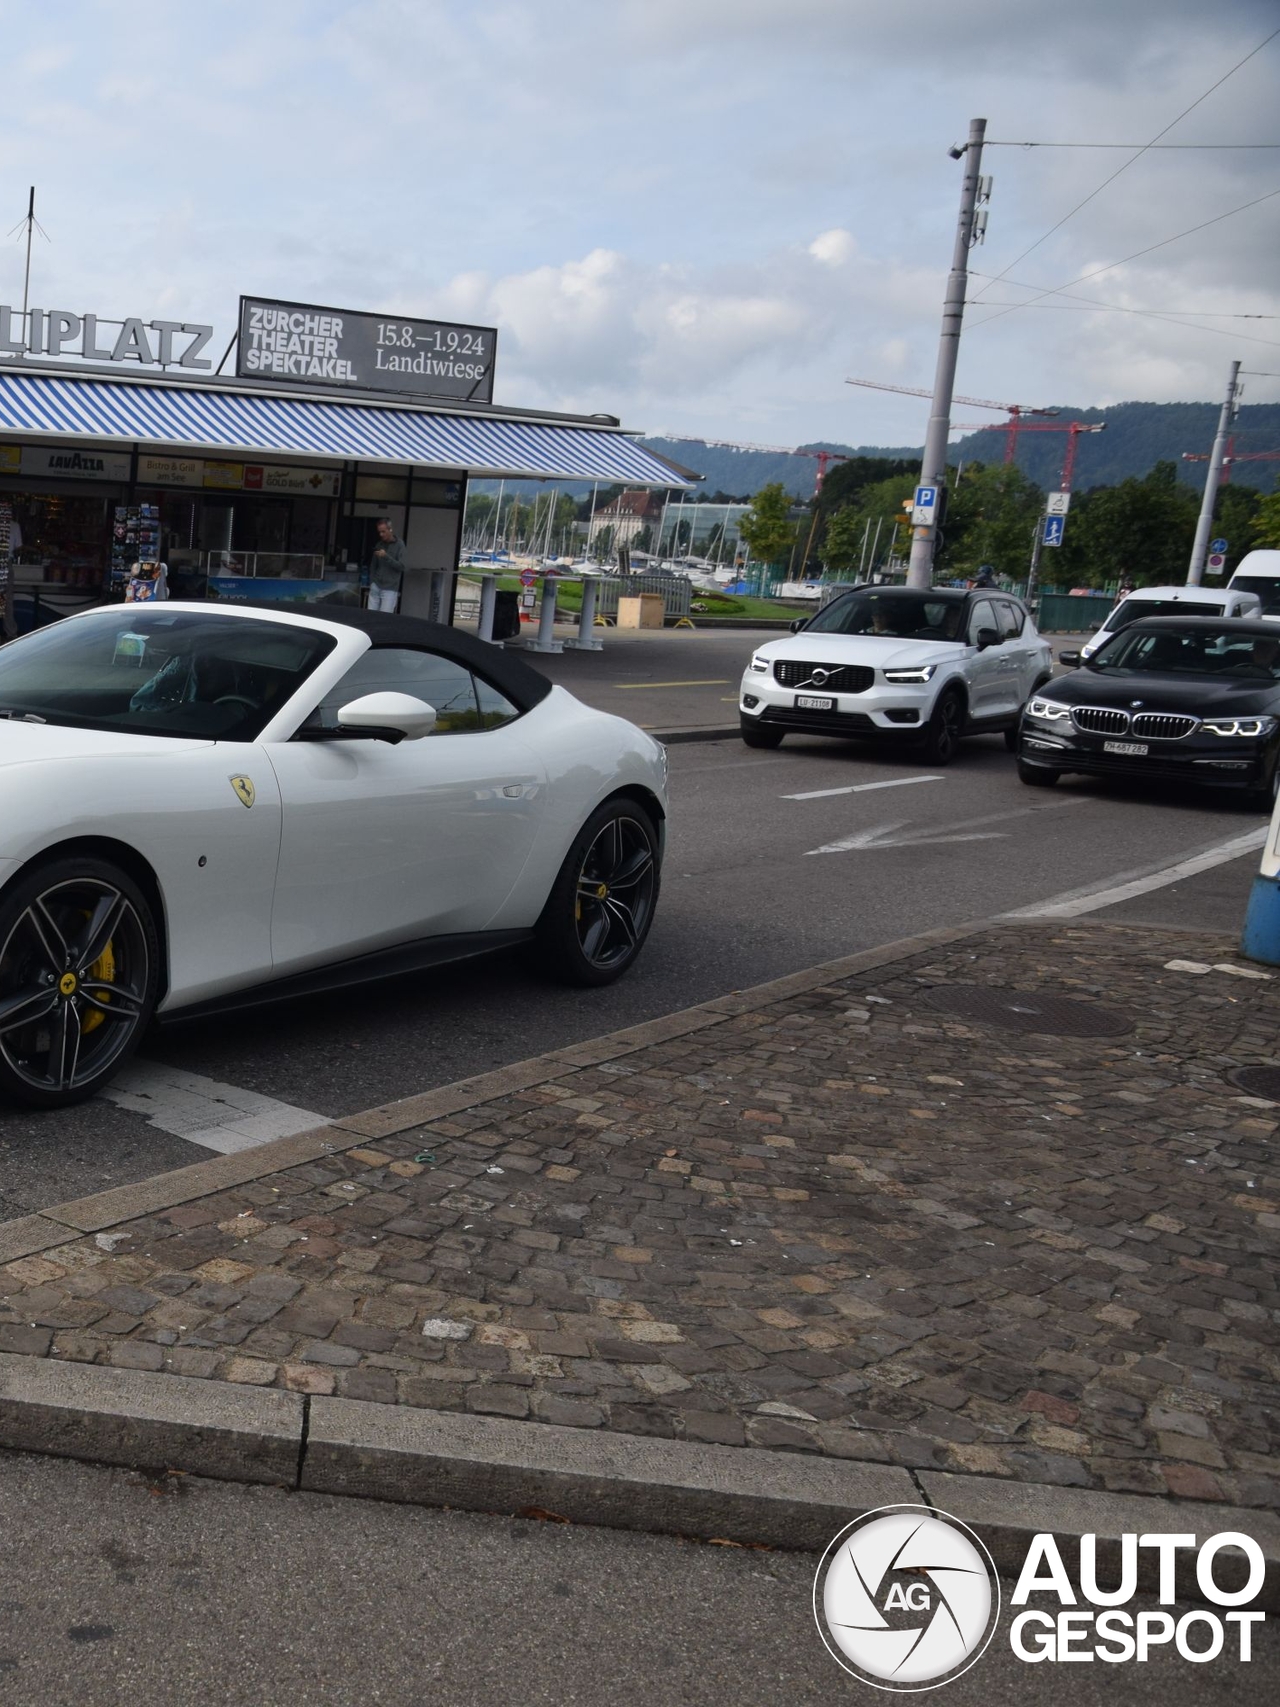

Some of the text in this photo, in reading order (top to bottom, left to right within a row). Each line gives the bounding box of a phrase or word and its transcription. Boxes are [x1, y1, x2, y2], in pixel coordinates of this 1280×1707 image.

[249, 307, 344, 339] ZÜRCHER
[248, 328, 339, 358] THEATER
[246, 349, 358, 381] SPEKTAKEL
[375, 348, 485, 380] Landiwiese
[48, 453, 104, 472] LAVAZZA
[146, 460, 195, 472] Bistro & Grill
[171, 473, 186, 482] See
[266, 478, 287, 487] GOLD
[920, 490, 932, 505] P
